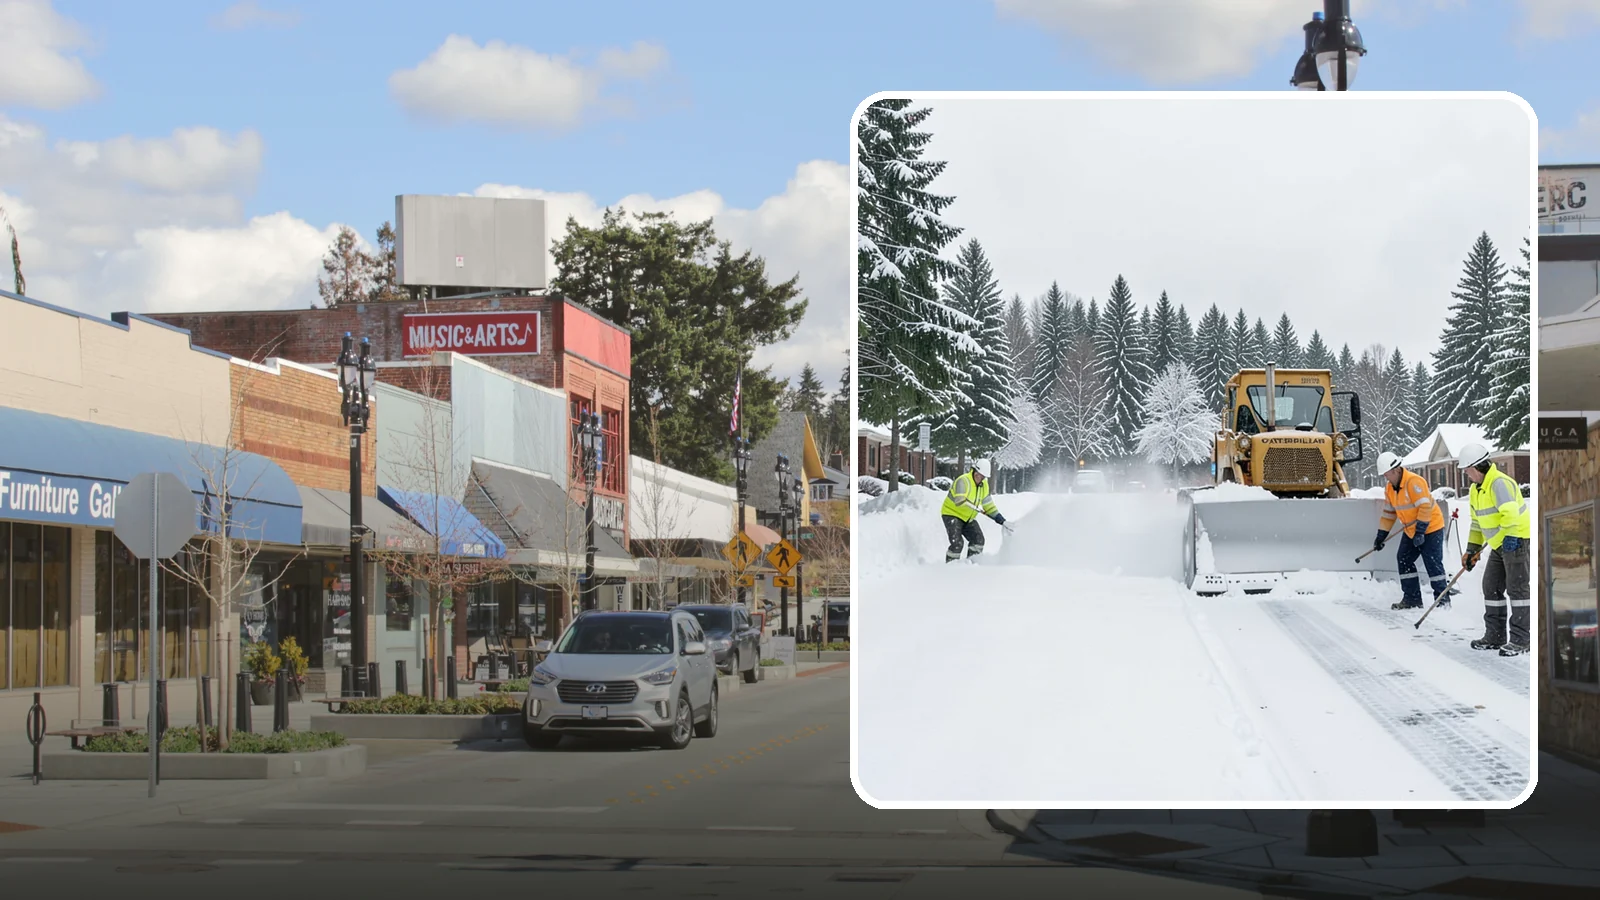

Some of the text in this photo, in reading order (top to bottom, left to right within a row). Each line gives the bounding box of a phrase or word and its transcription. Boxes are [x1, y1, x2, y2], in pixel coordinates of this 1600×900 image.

[408, 322, 519, 349] MUSIC&ARTS
[0, 471, 122, 519] Furniture Gal
[453, 562, 479, 574] SUSHI
